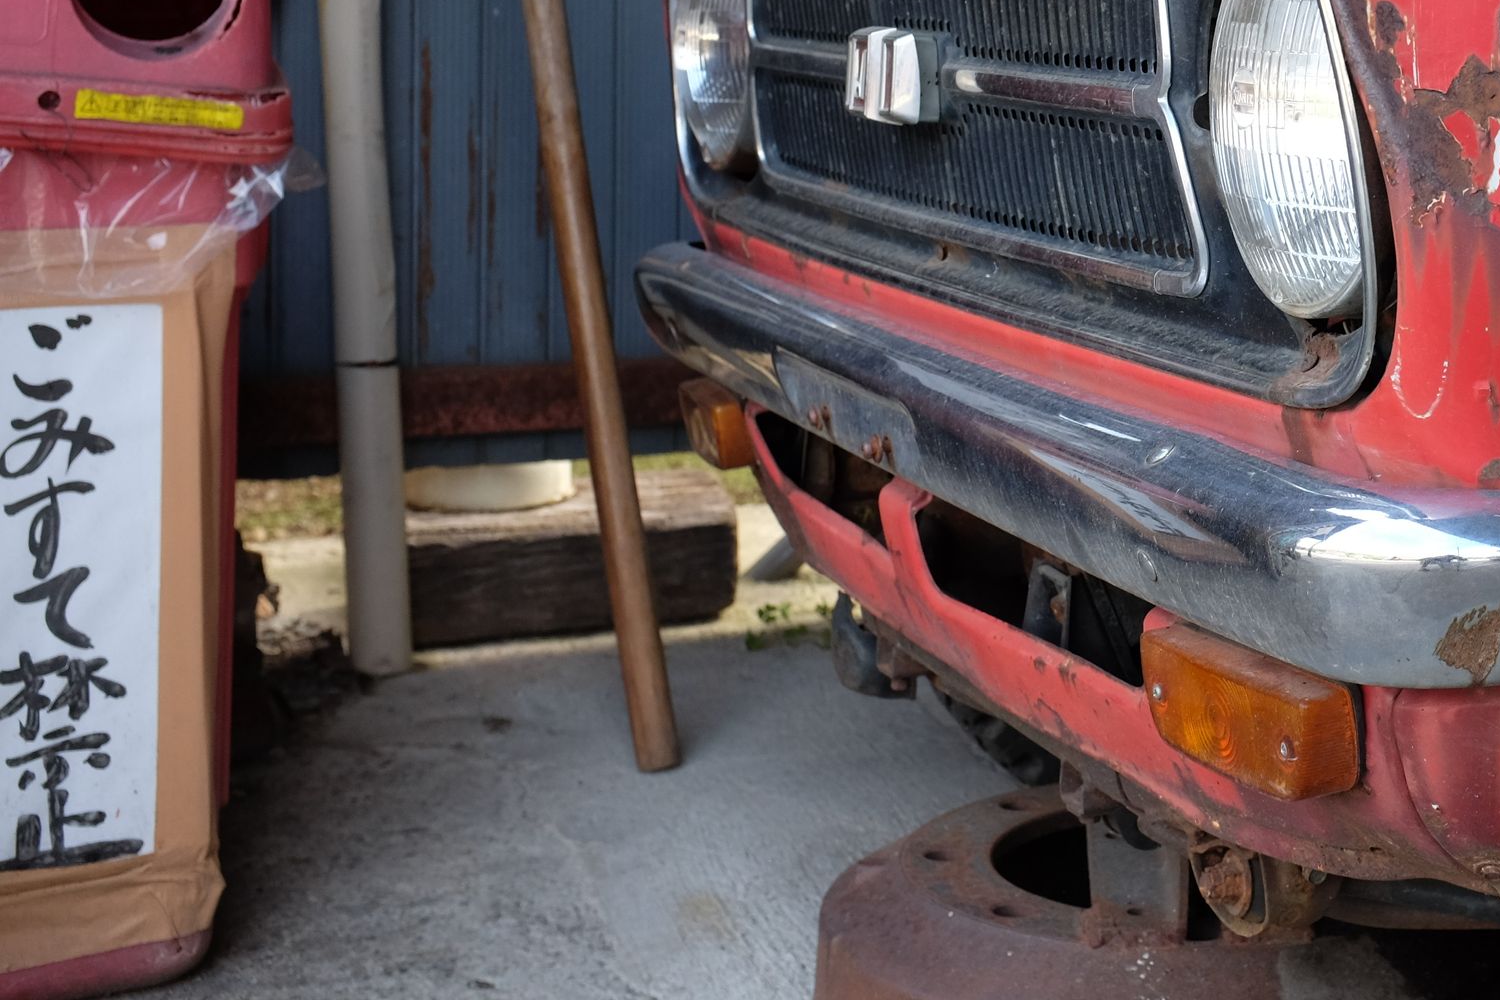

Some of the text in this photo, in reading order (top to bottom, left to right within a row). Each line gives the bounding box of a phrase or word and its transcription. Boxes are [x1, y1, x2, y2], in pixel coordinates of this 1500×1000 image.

[0, 315, 143, 869] ごみすて禁止
